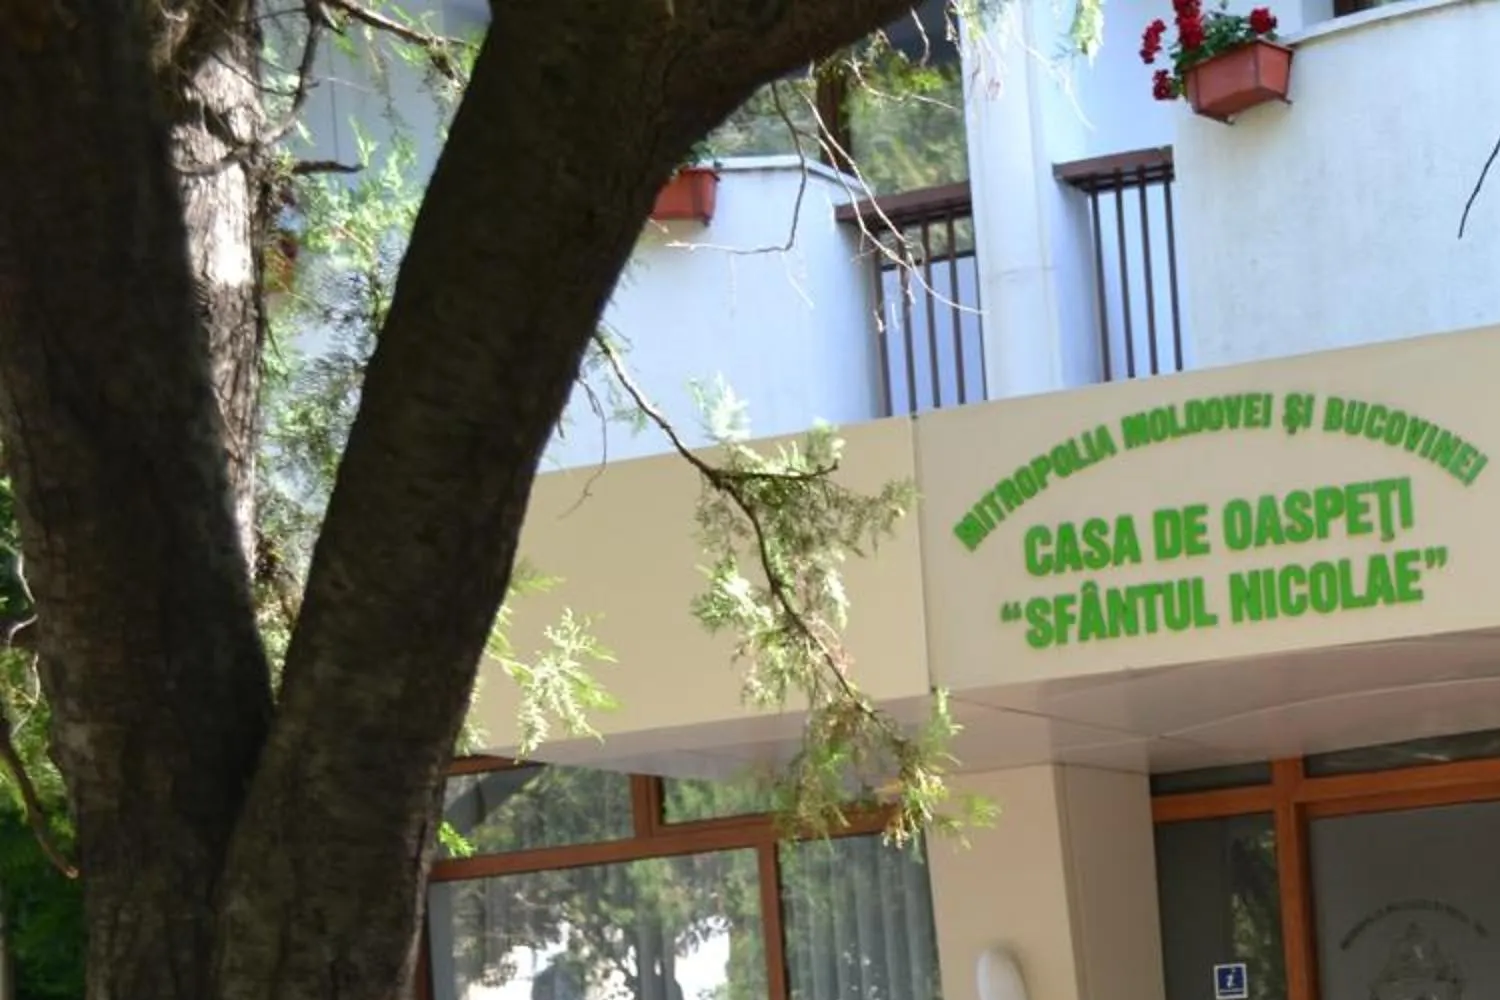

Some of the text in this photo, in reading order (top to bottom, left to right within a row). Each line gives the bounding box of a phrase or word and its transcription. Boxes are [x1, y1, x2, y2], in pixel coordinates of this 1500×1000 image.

[953, 424, 1119, 553] MITROPOLIA
[1120, 391, 1274, 450] MOLDOVEI
[1322, 396, 1489, 487] BUCOVINEI
[1022, 514, 1142, 577] CASA
[1152, 503, 1212, 561] DE
